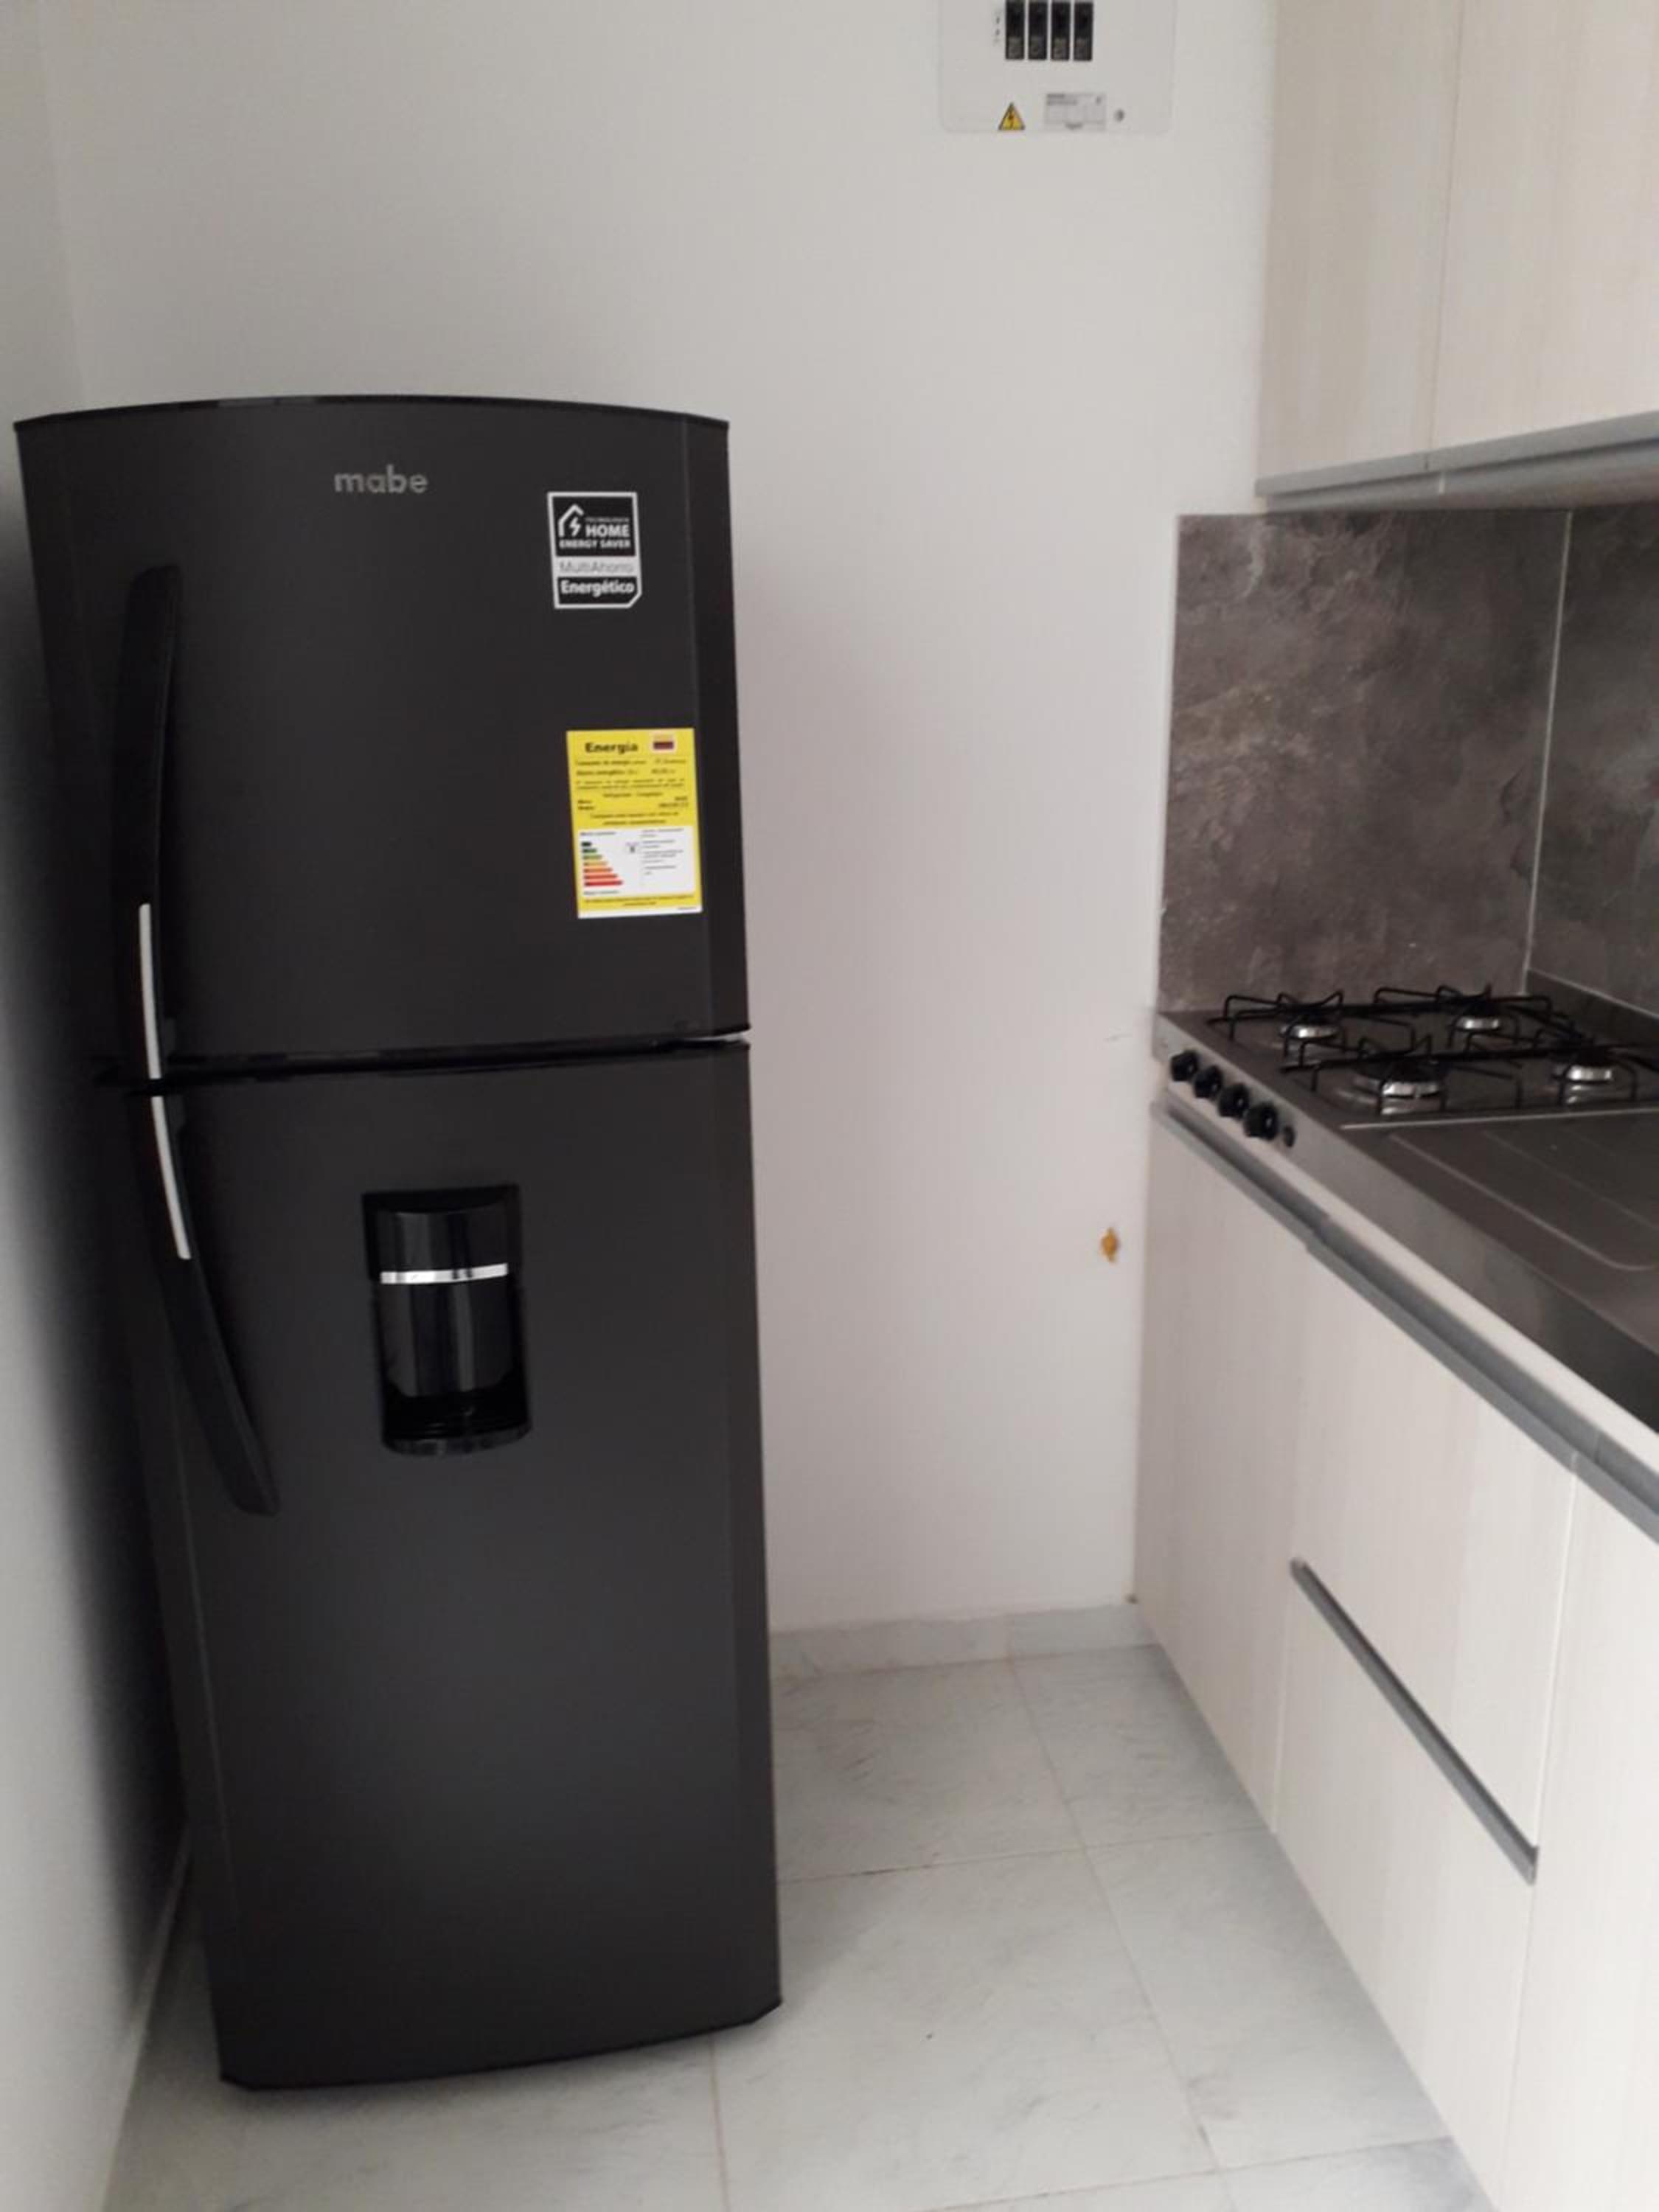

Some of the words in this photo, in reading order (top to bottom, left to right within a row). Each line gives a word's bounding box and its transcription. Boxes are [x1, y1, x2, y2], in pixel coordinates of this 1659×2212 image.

[334, 464, 428, 493] mabe
[585, 524, 630, 538] HOME
[558, 539, 598, 549] ENERGY
[599, 539, 631, 549] SAVER
[560, 579, 636, 598] Energético
